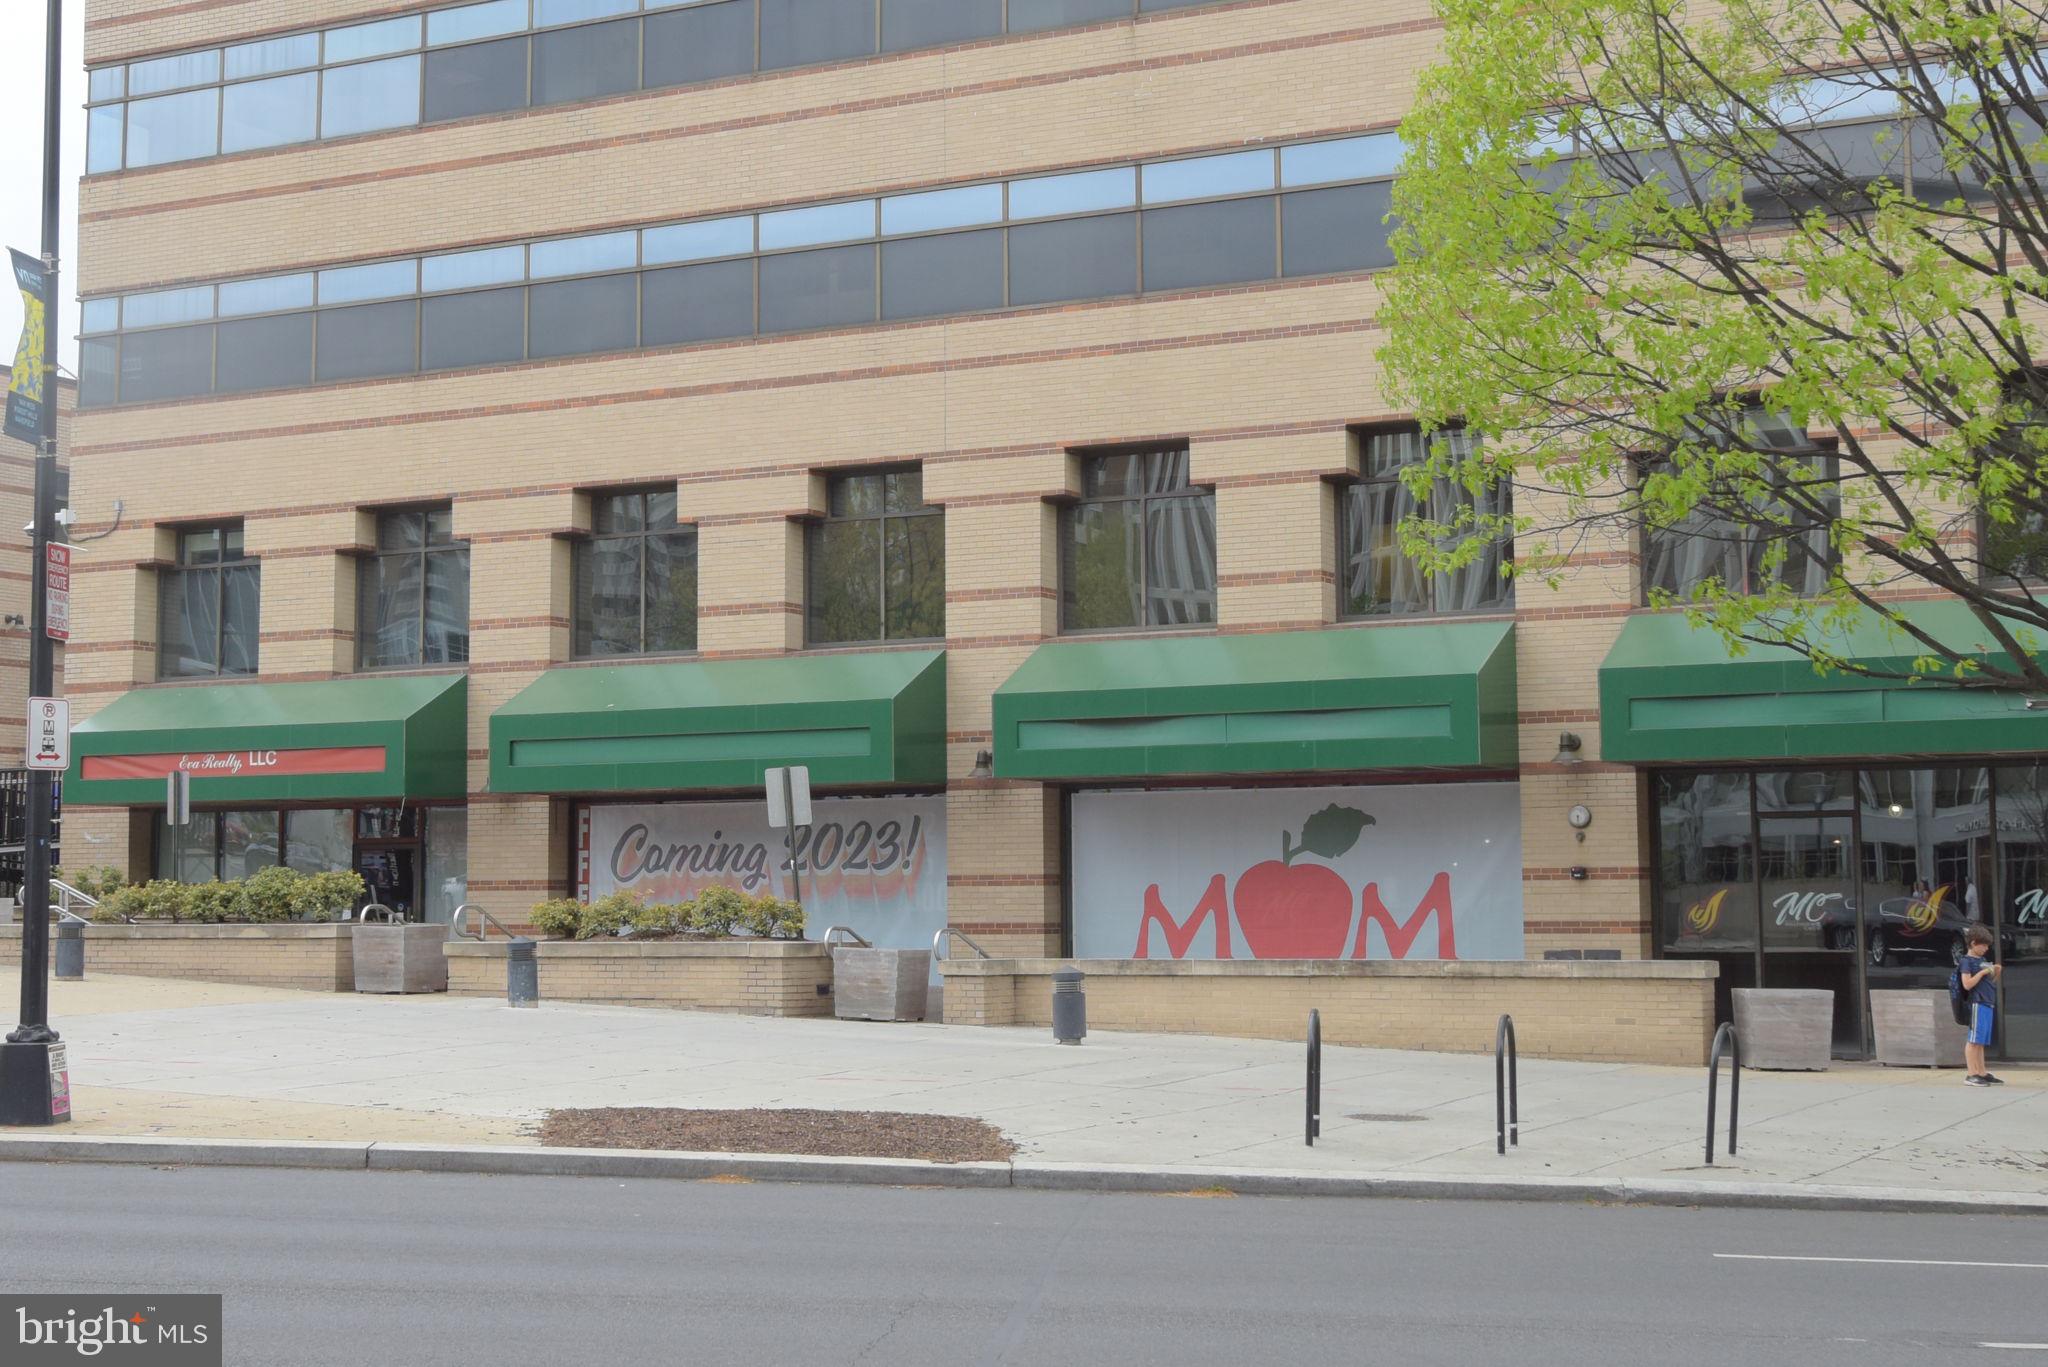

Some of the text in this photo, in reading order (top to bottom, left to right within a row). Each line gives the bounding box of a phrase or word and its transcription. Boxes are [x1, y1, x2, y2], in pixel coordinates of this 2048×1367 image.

[249, 751, 277, 766] LLC
[610, 815, 922, 890] Coming 2023!
